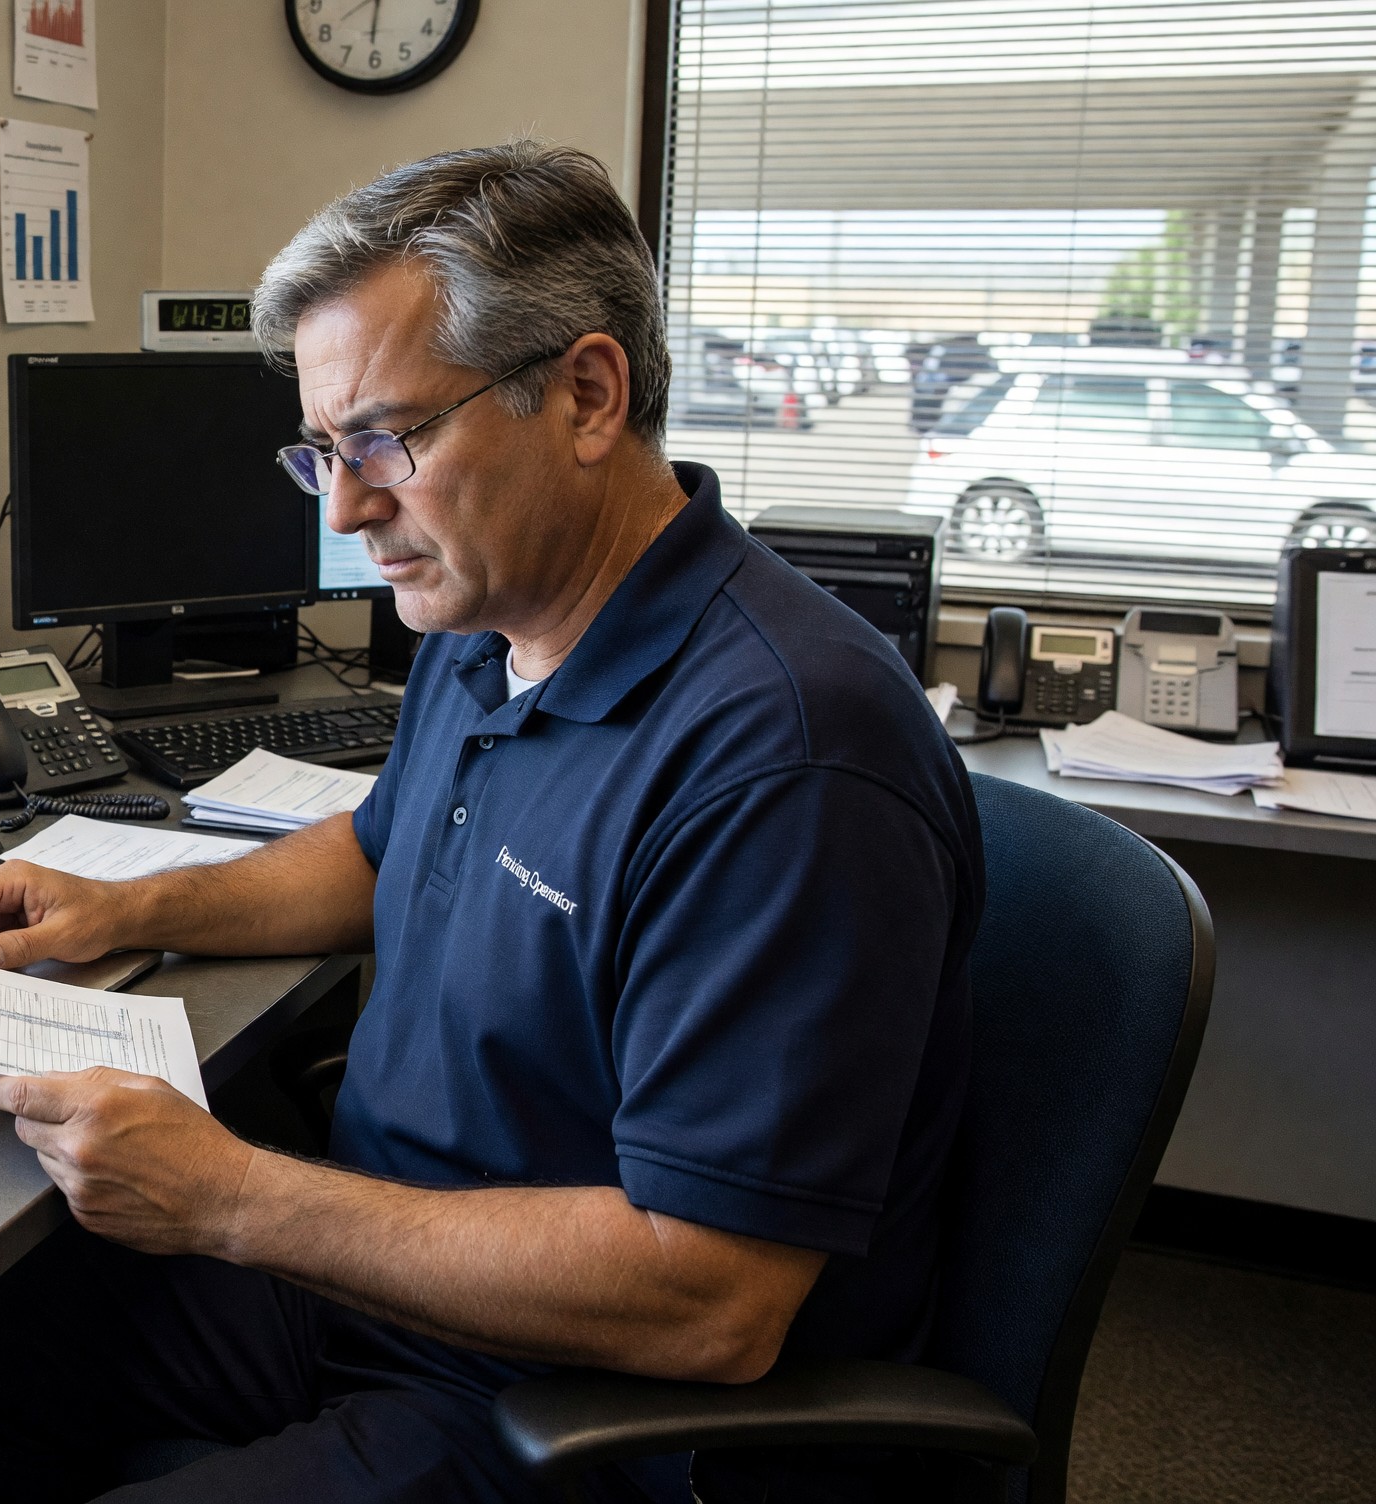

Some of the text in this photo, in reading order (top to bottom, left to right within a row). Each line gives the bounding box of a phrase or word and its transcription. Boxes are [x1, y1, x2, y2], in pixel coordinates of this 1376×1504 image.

[318, 24, 332, 43] 8
[420, 18, 432, 36] 4
[340, 45, 353, 64] 7
[368, 50, 382, 69] 6
[398, 42, 411, 61] 5
